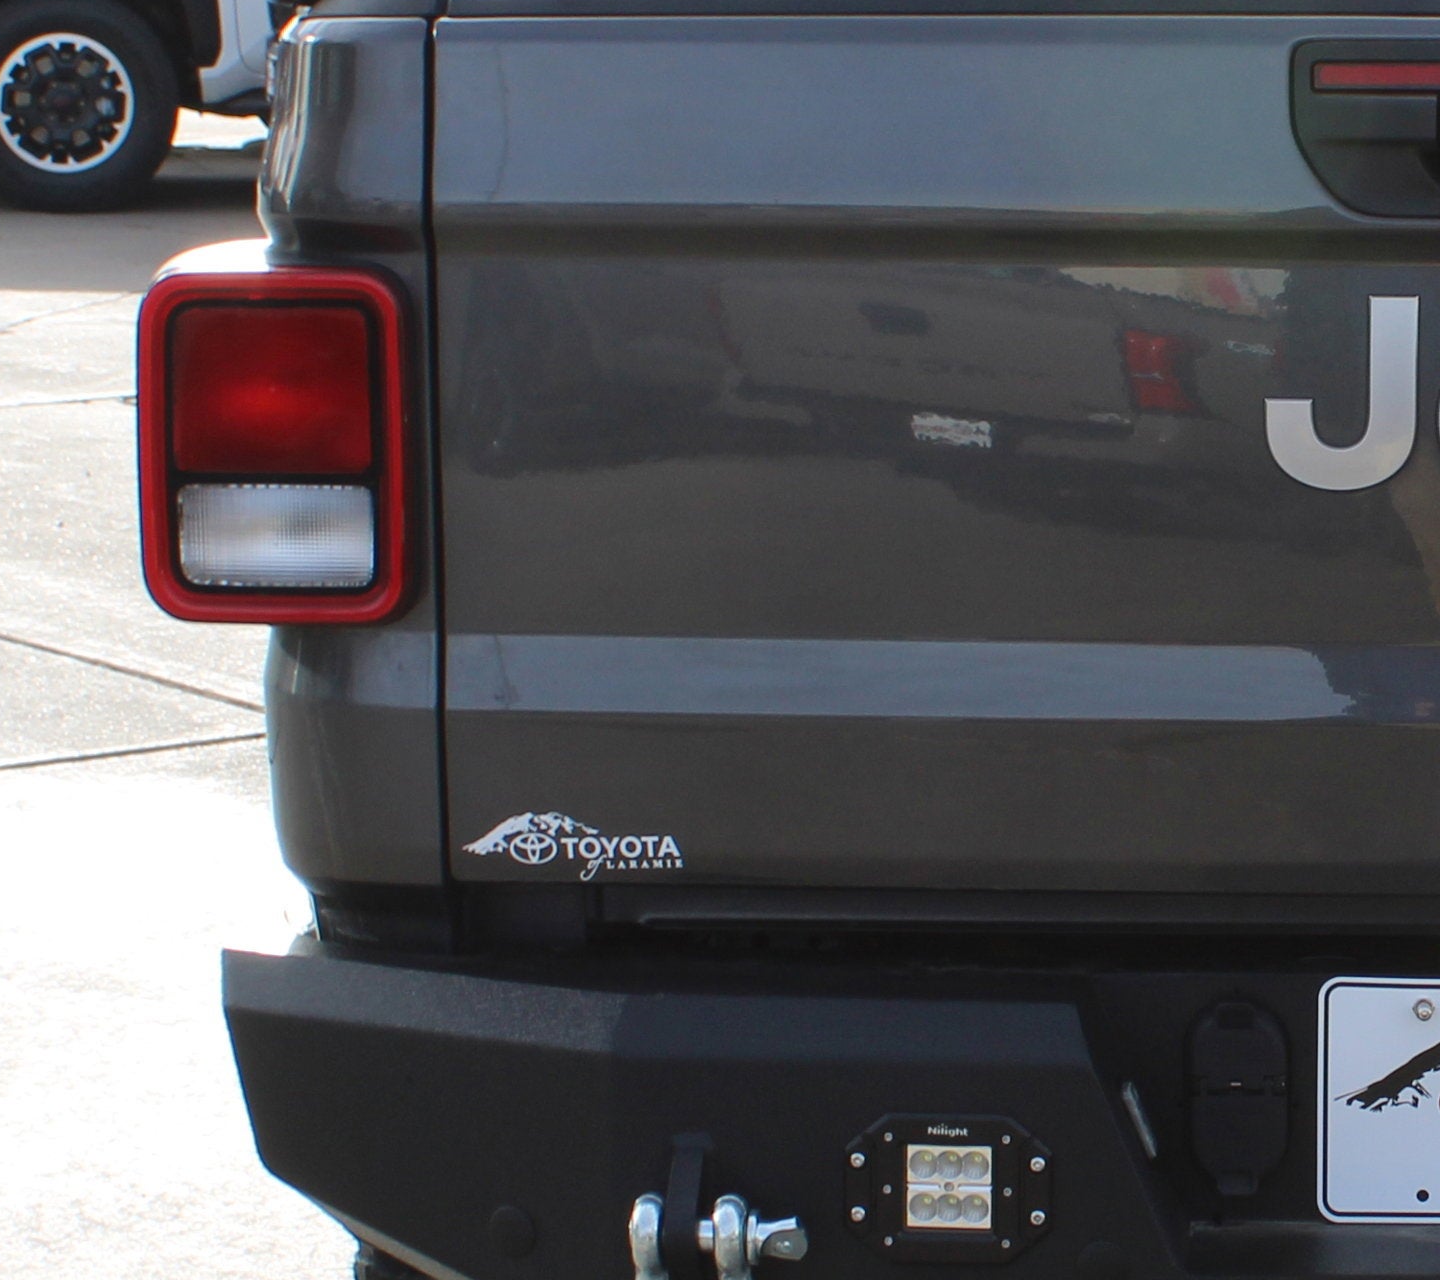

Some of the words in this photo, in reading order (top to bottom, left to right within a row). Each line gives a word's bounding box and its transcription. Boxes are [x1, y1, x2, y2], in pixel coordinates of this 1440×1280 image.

[560, 835, 681, 860] TOYOTA
[579, 854, 607, 881] of
[607, 858, 684, 870] LARAMIE
[927, 1123, 969, 1138] Nilight
